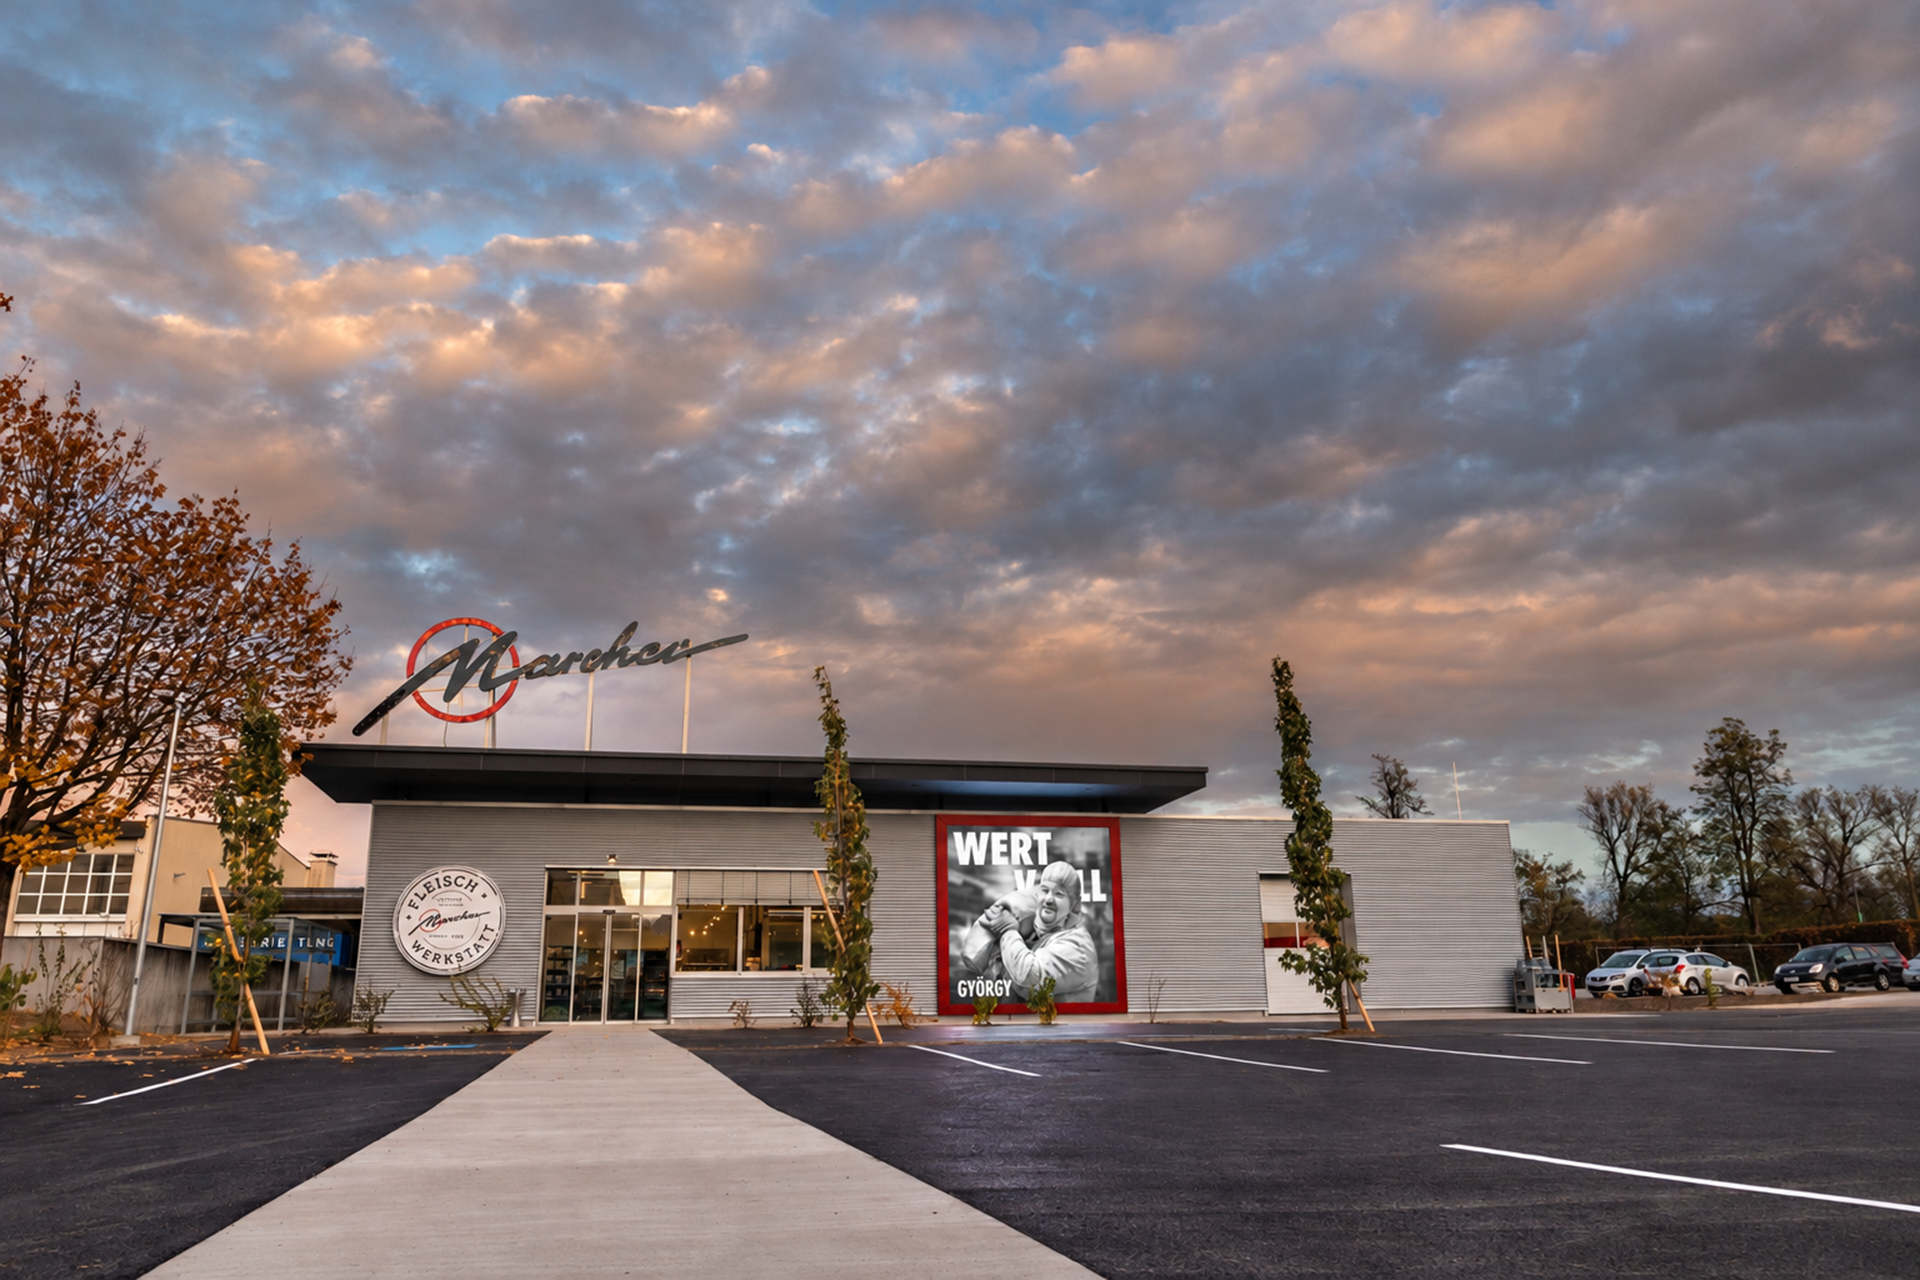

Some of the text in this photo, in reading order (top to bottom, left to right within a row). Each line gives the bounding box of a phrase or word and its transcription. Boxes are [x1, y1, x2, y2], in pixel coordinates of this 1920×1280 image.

[953, 831, 1052, 866] WERT
[407, 875, 479, 911] FLEISCH
[1013, 869, 1107, 902] VLL
[411, 923, 496, 965] WERKSTATT
[957, 975, 1012, 998] GYÖRGY
